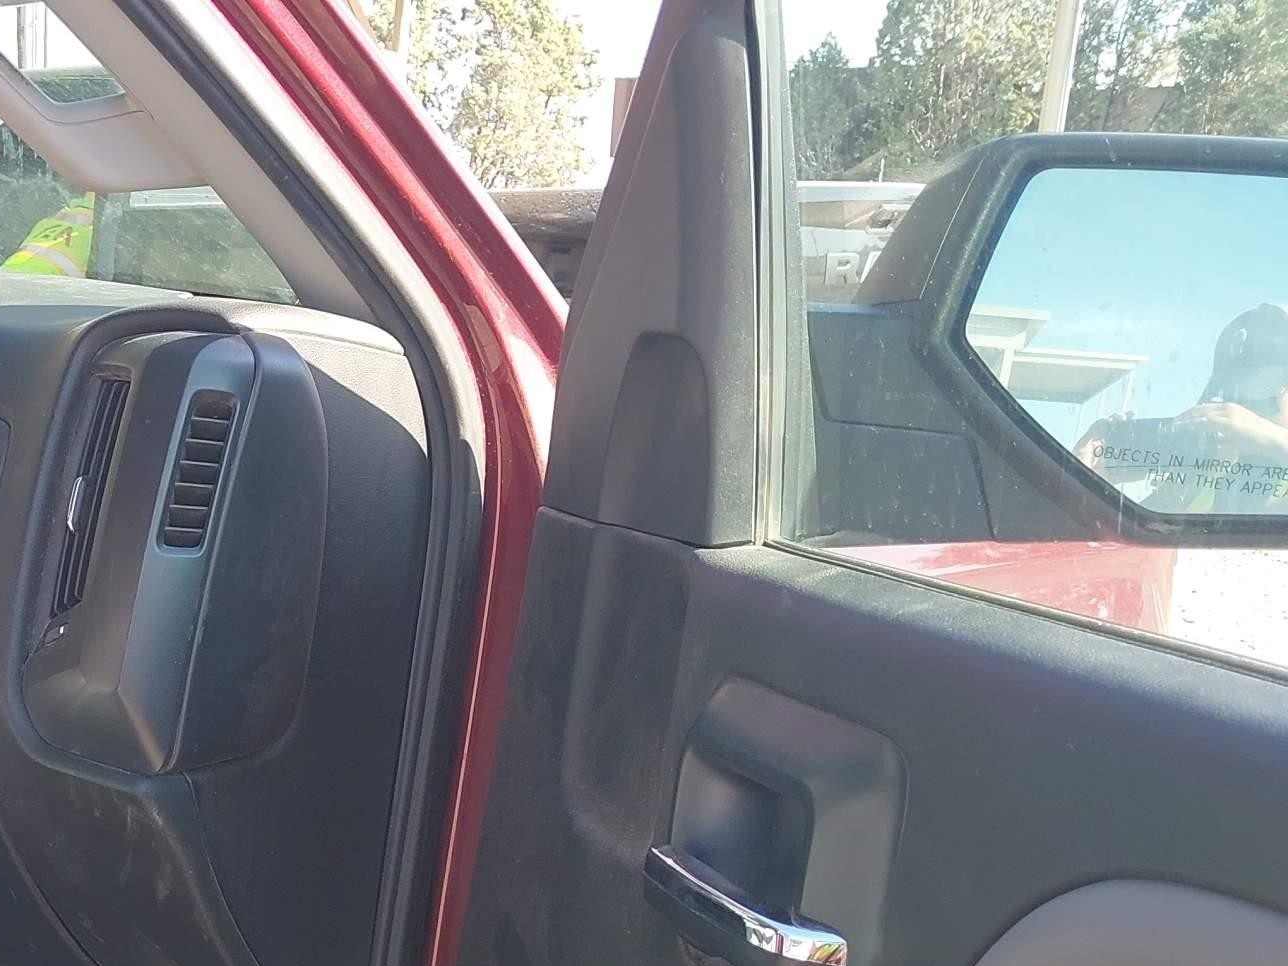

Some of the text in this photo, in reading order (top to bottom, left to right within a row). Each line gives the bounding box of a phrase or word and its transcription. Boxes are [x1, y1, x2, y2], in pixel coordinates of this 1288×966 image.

[1093, 446, 1161, 465] OBJECTS
[1168, 454, 1185, 467] IN
[1193, 458, 1253, 477] MIRROR
[1147, 468, 1187, 485] THAN
[1196, 474, 1236, 491] THEY
